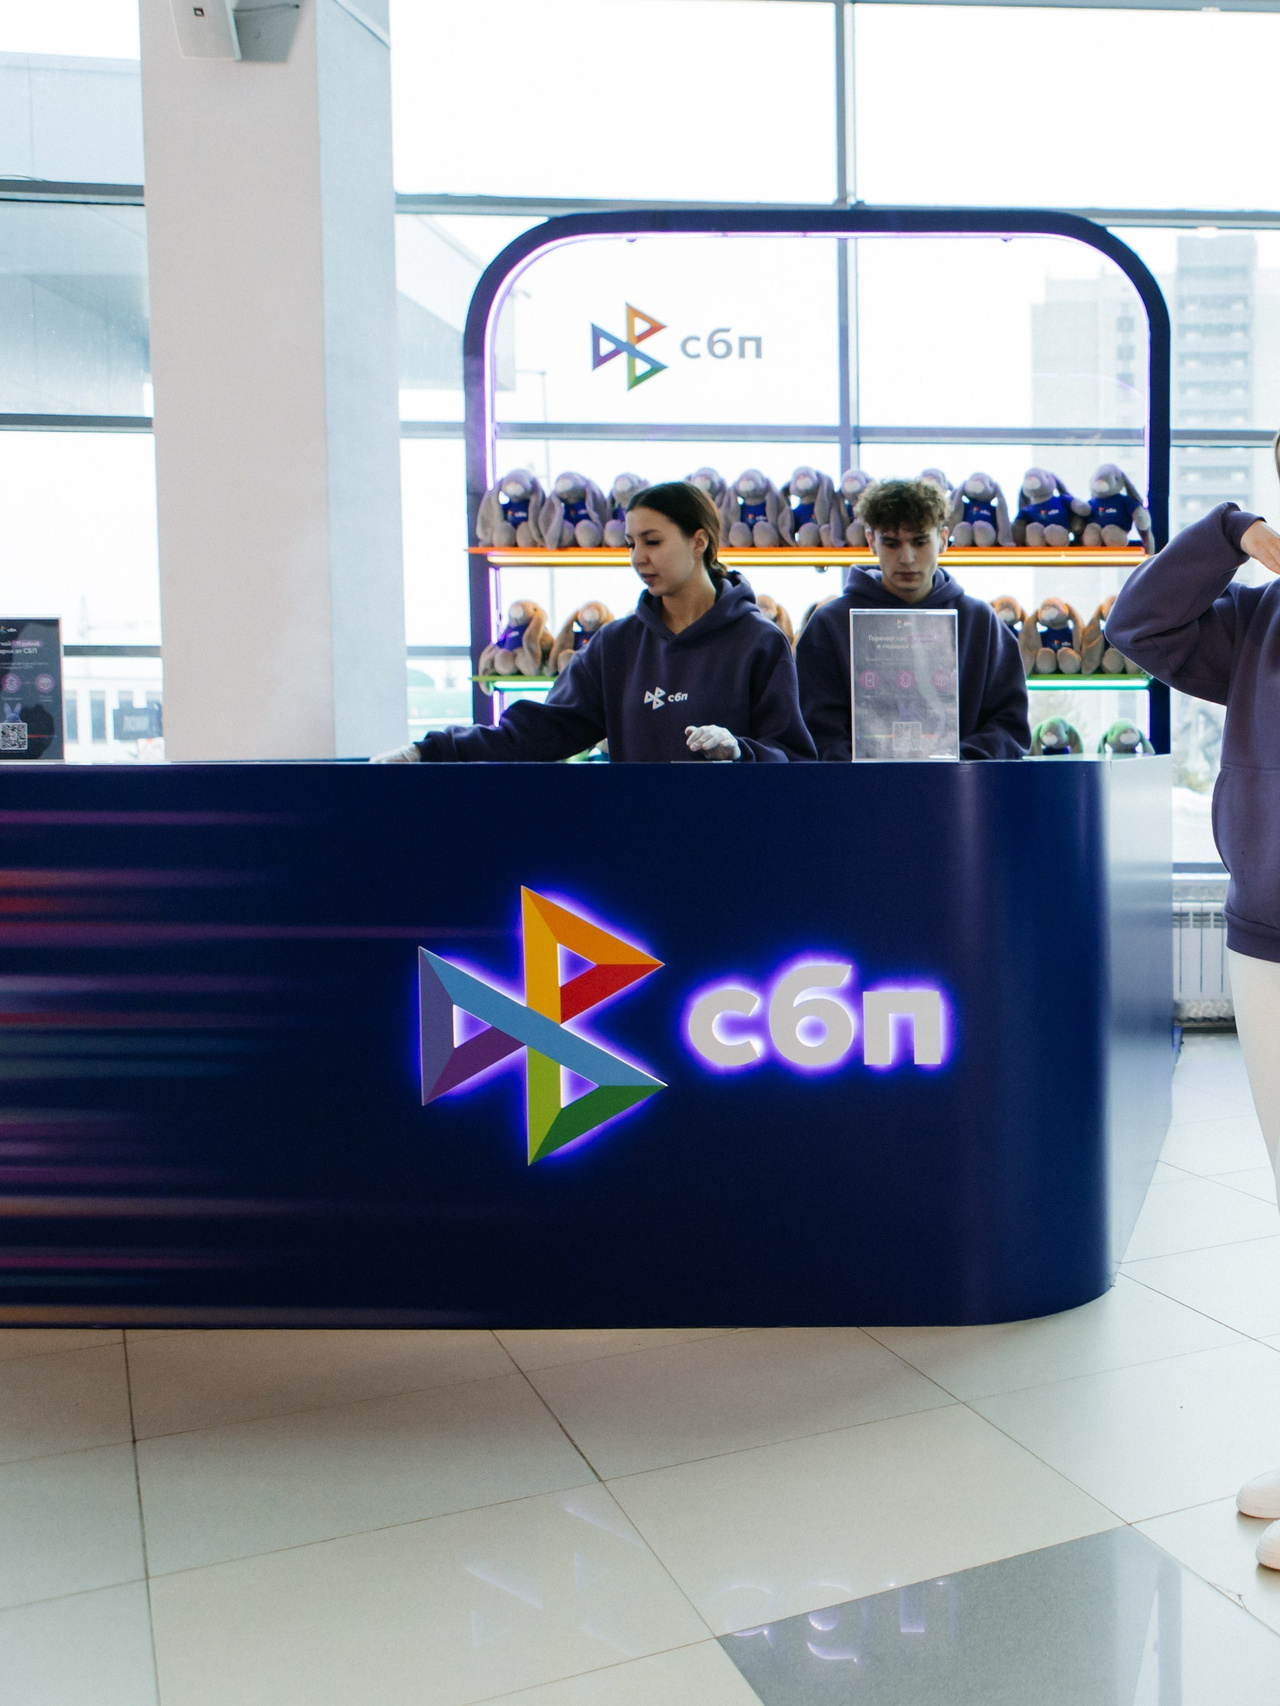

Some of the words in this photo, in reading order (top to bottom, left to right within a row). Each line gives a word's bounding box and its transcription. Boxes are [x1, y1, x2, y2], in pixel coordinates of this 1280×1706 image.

[680, 327, 762, 360] сбп
[667, 692, 689, 703] сбп
[688, 964, 942, 1067] сбп
